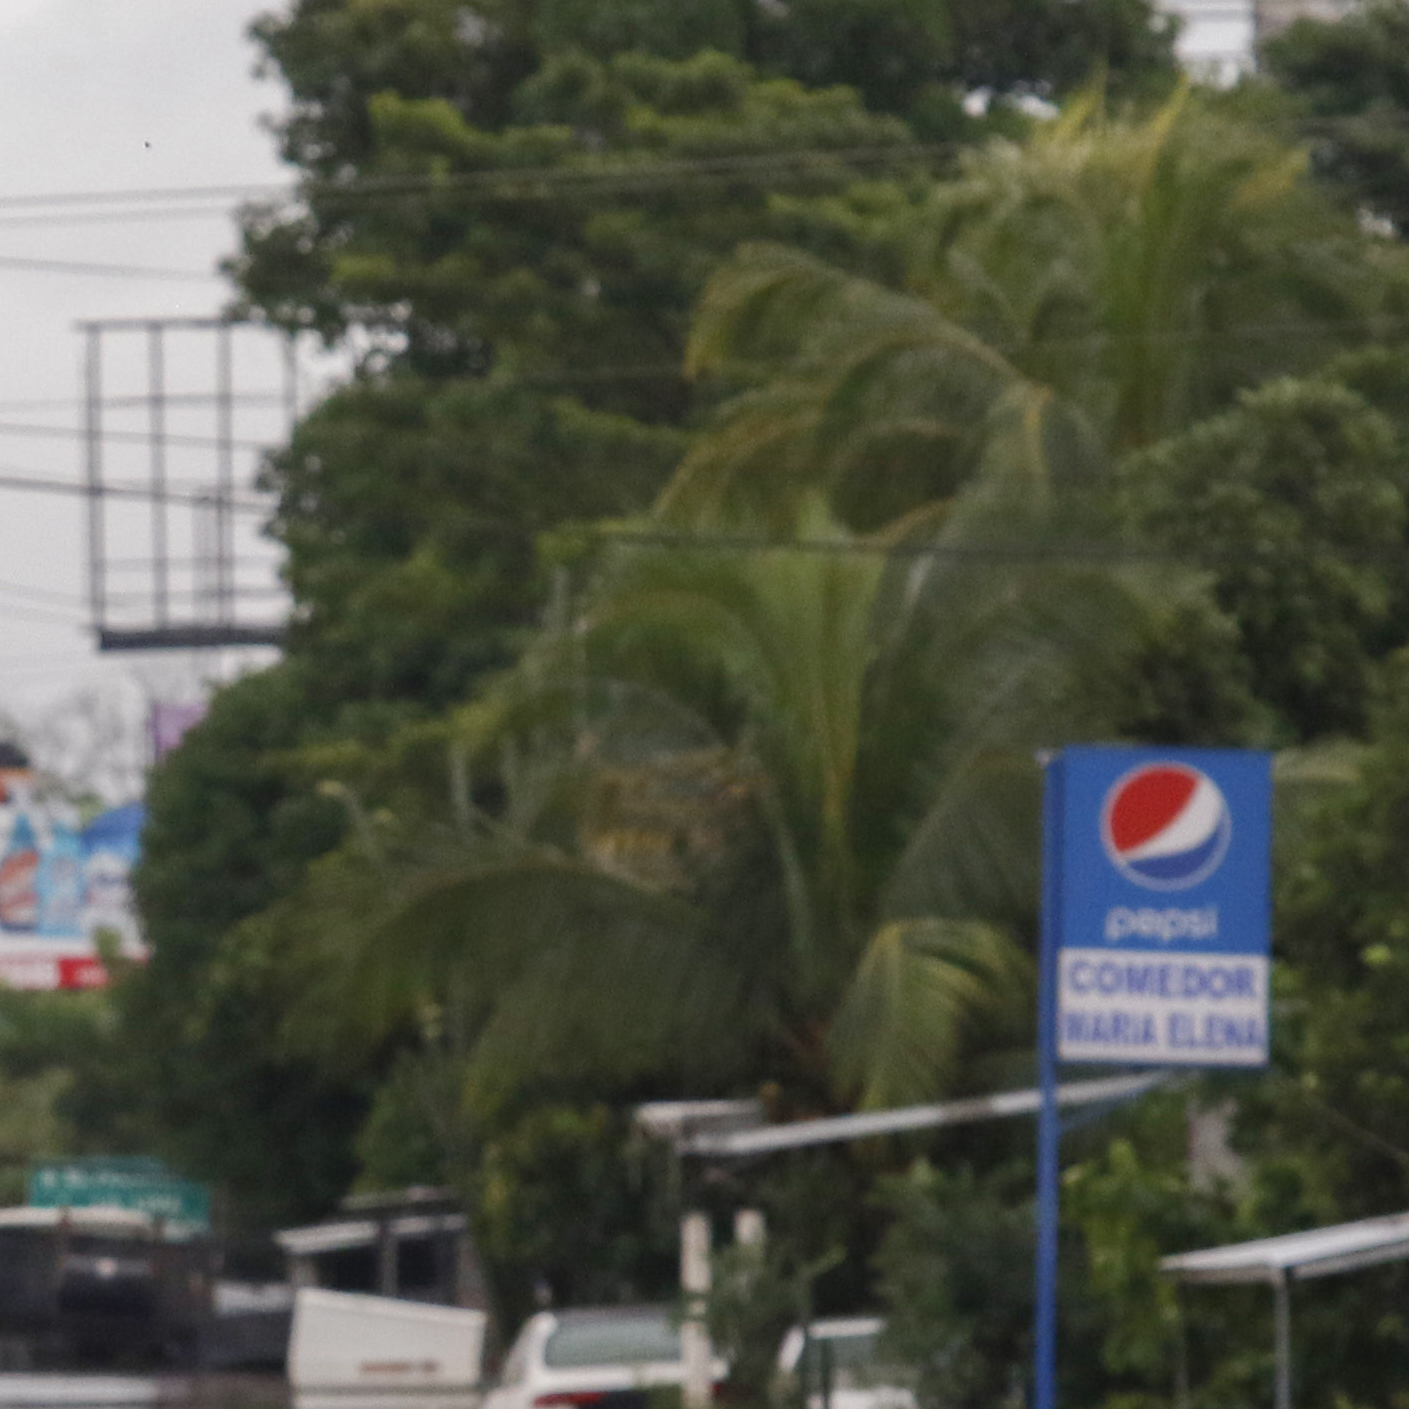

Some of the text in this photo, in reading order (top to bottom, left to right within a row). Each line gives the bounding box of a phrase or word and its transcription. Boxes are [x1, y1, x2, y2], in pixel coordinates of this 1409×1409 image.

[1105, 905, 1219, 942] pepsi
[1068, 961, 1256, 998] COMEDOR
[1064, 1011, 1265, 1048] MARIA ELENA
